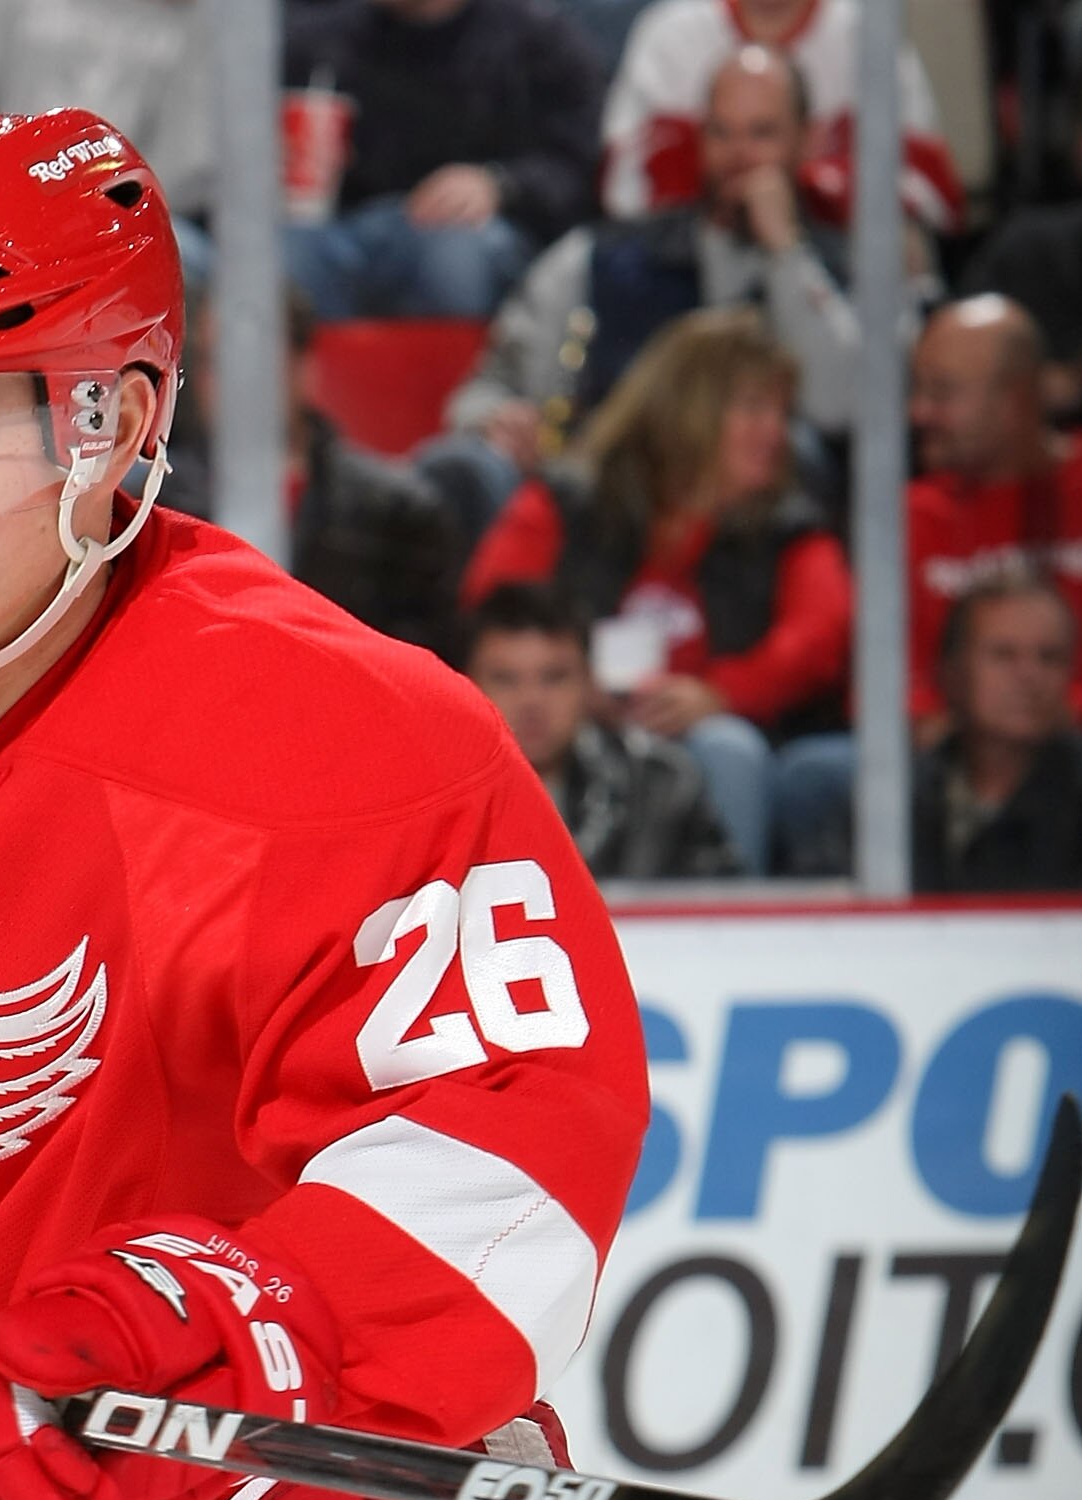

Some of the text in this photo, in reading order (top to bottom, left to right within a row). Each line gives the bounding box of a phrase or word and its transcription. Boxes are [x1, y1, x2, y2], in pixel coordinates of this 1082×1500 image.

[28, 150, 75, 183] Red
[352, 858, 591, 1092] 26
[263, 1277, 293, 1303] 26
